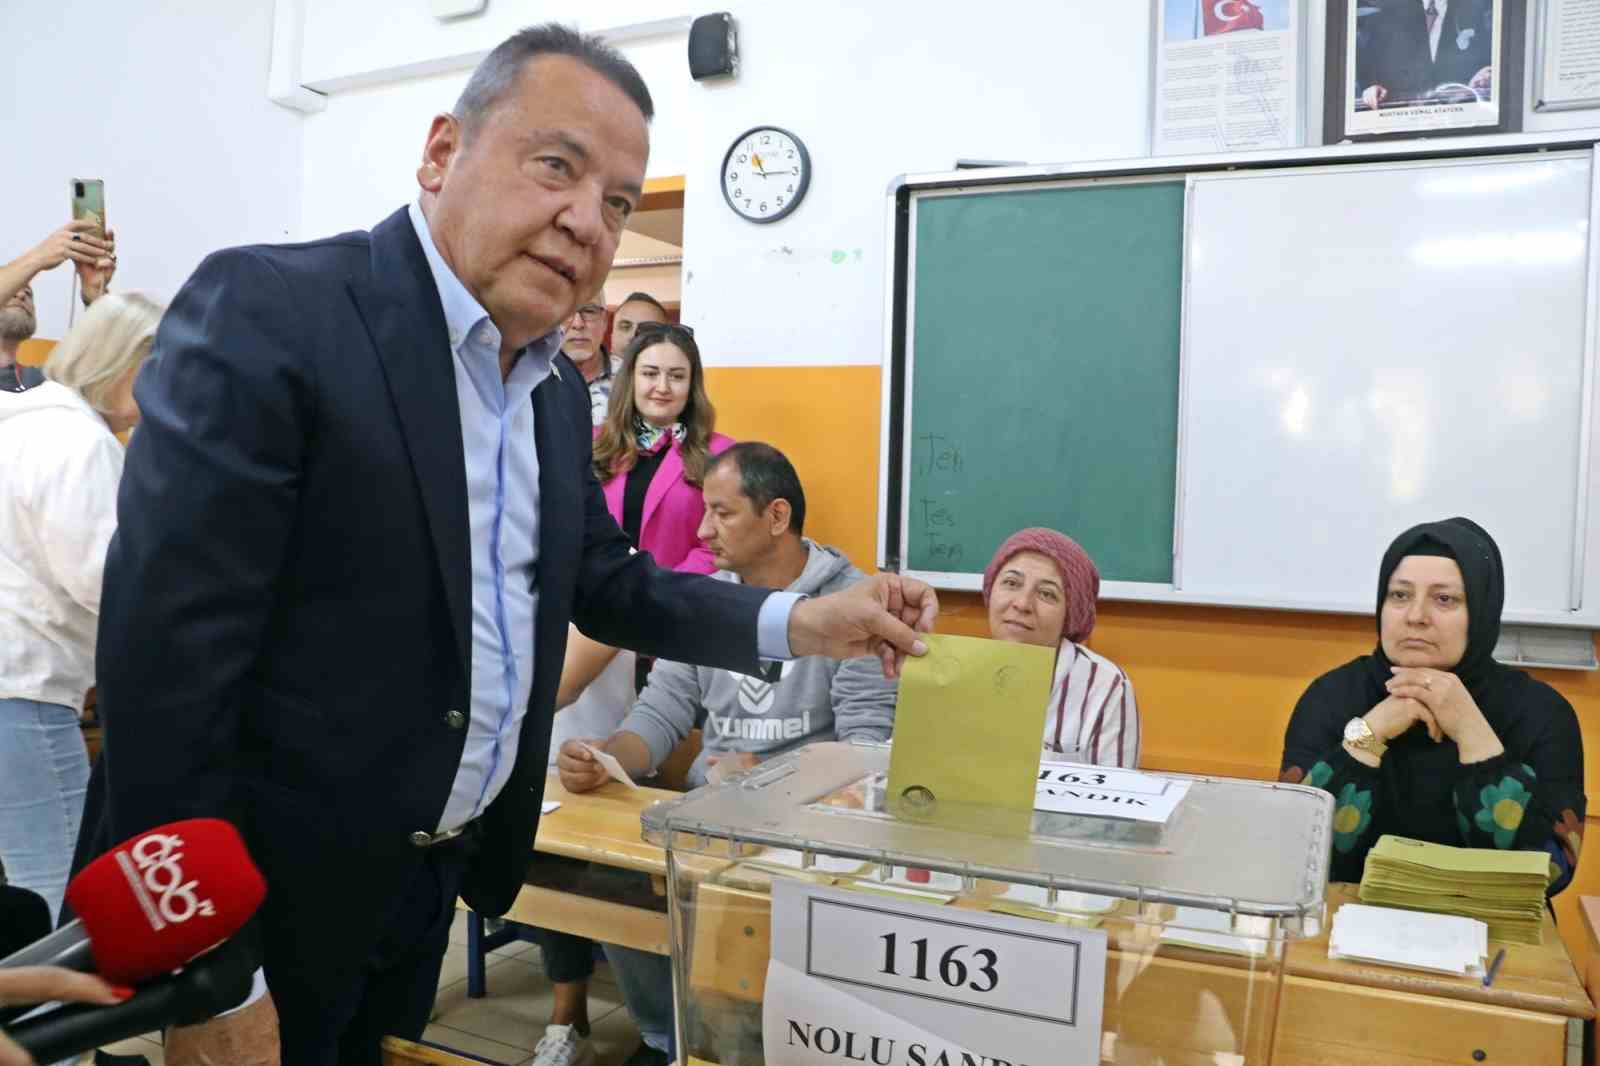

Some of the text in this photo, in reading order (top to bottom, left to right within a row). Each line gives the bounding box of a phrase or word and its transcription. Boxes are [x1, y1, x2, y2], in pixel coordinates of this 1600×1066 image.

[760, 135, 770, 145] 12
[786, 148, 794, 159] 2
[730, 171, 738, 182] 9
[791, 165, 799, 177] 3
[734, 187, 742, 198] 8
[786, 183, 793, 193] 4
[743, 198, 752, 209] 7
[759, 201, 768, 212] 6
[776, 195, 784, 207] 5
[1037, 769, 1107, 785] 163
[1040, 788, 1148, 807] ANDIK
[878, 931, 1000, 993] 1163
[785, 1018, 1031, 1066] NOLU SAN
